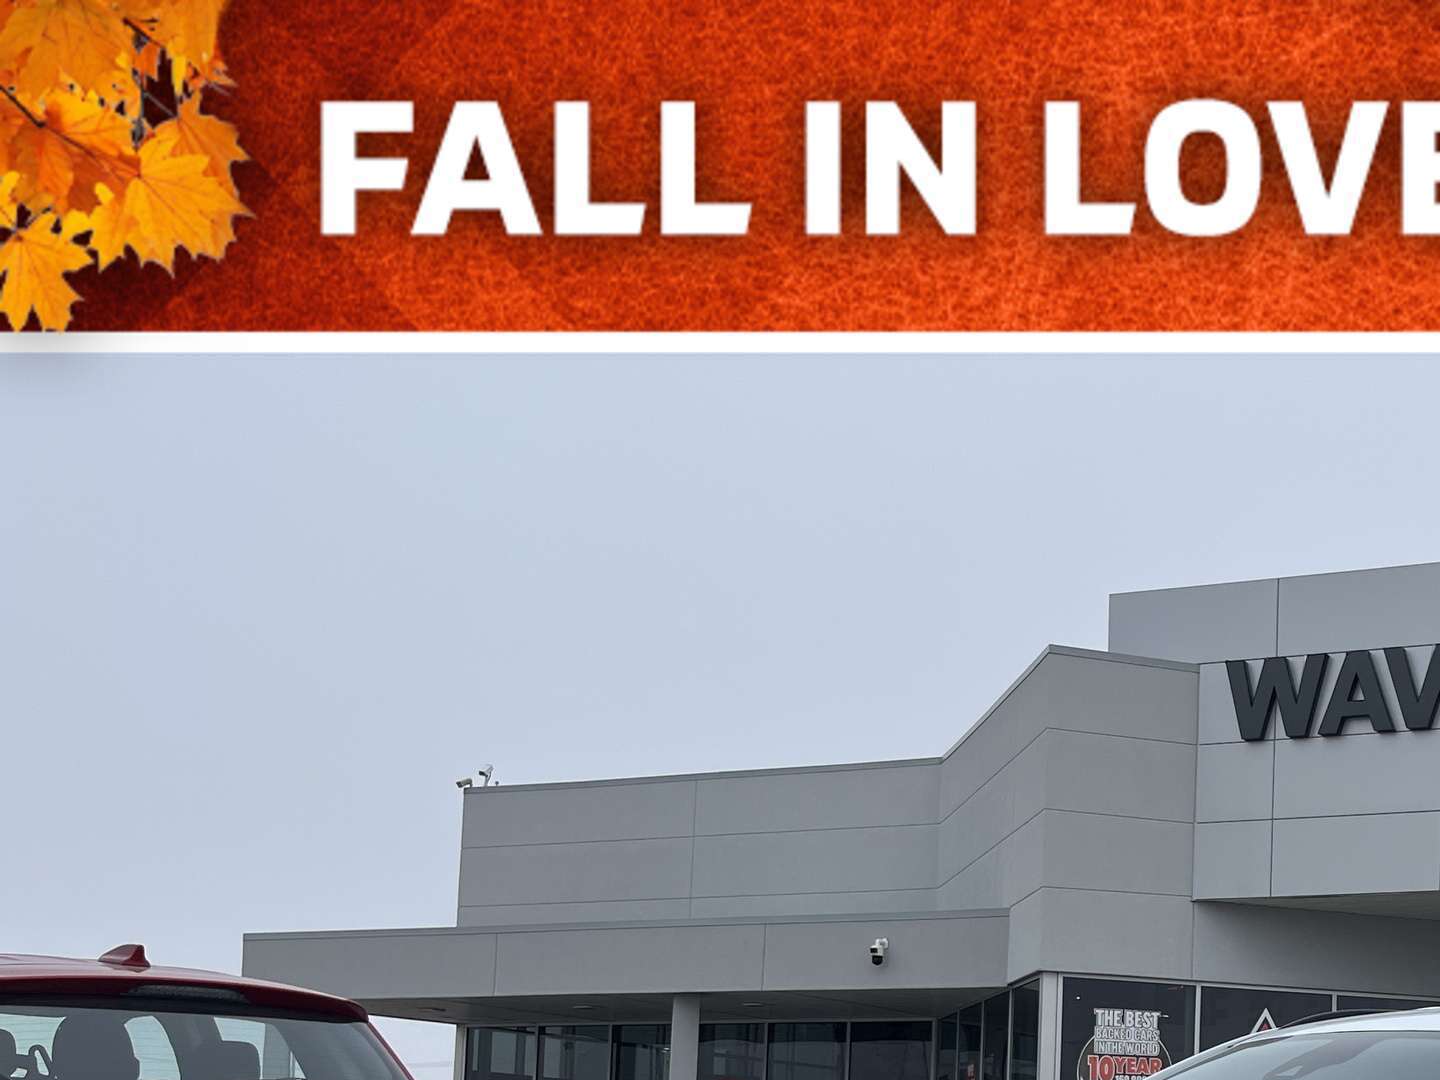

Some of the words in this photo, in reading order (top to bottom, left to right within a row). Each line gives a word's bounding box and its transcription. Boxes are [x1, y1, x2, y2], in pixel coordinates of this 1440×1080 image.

[1094, 1008, 1122, 1027] THE
[1124, 1010, 1160, 1029] BEST
[1096, 1027, 1133, 1040] BACKED
[1134, 1029, 1159, 1041] CARS
[1106, 1041, 1123, 1053] THE
[1126, 1042, 1159, 1055] WORLD
[1113, 1056, 1162, 1075] YEAR
